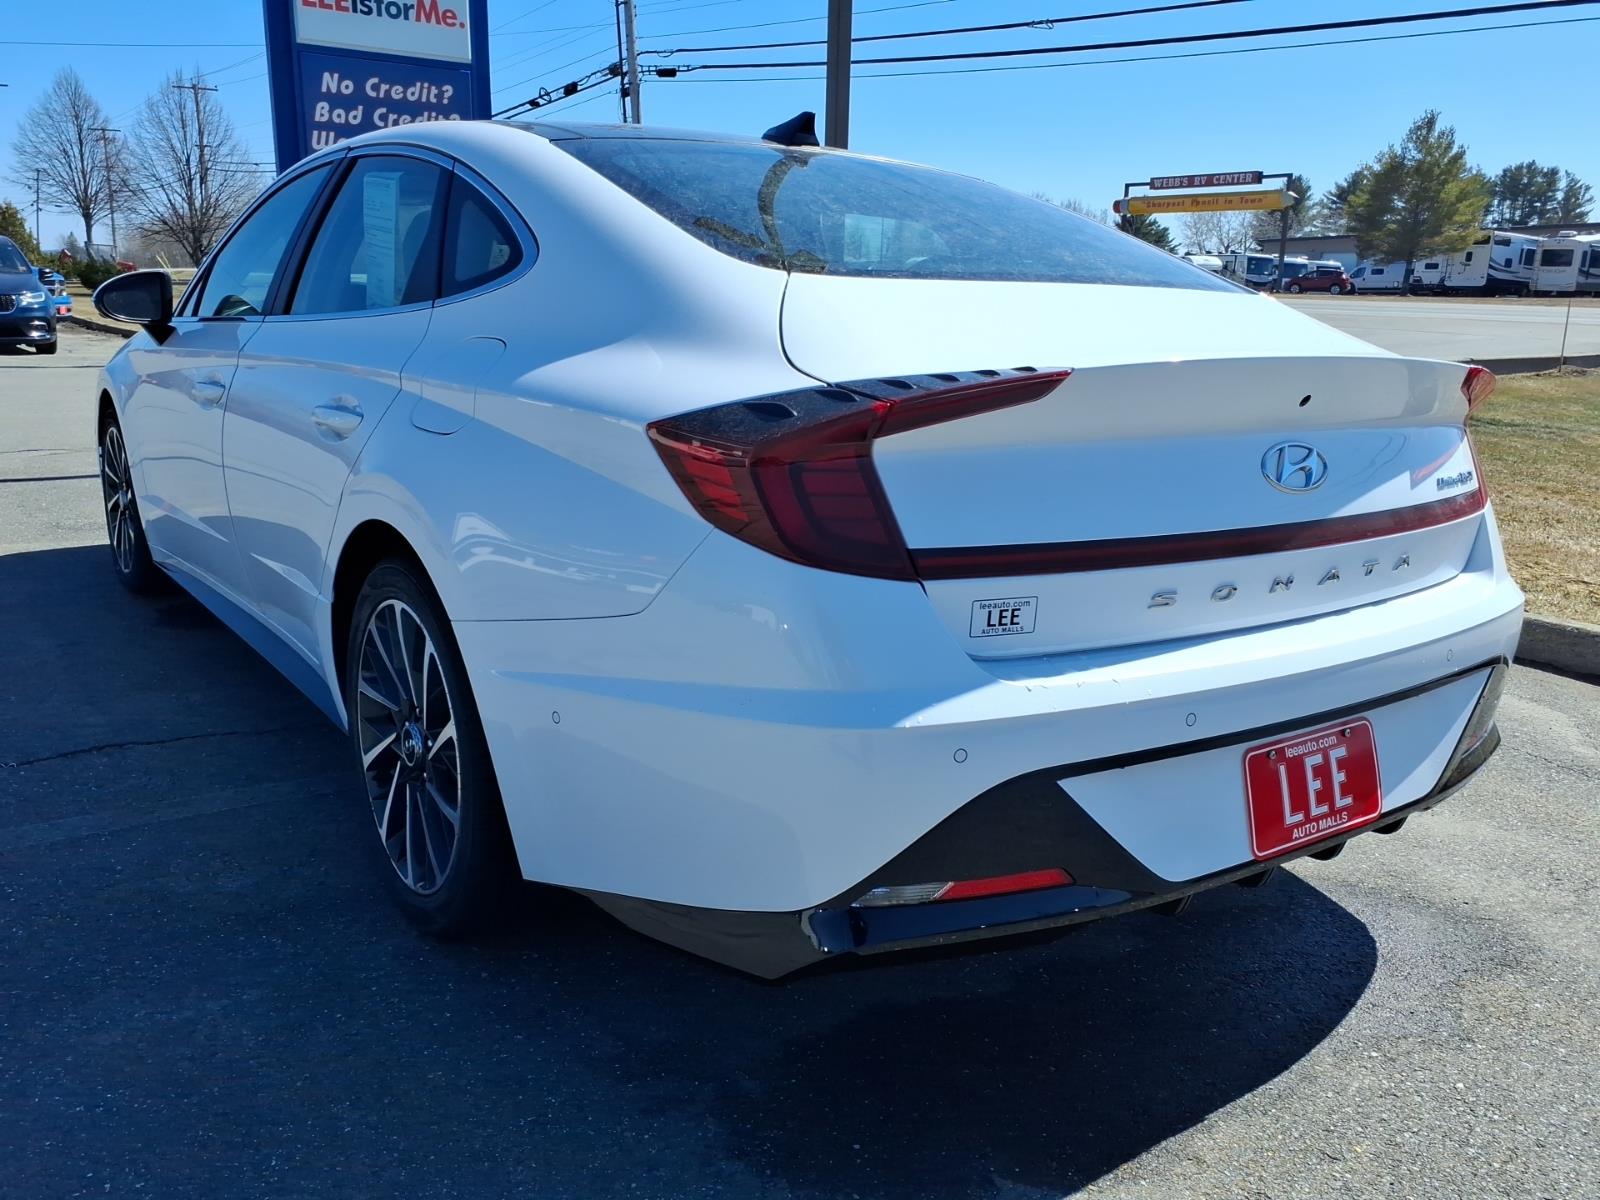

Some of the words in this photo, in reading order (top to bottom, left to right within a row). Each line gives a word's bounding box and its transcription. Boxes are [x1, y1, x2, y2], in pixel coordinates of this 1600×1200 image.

[301, 0, 466, 29] isforMe.
[322, 72, 354, 95] No
[366, 78, 453, 104] Credit?
[314, 101, 363, 124] Bad
[1153, 177, 1189, 188] WEBB'S
[1193, 175, 1208, 186] RV
[1213, 172, 1253, 184] CENTER
[1147, 551, 1411, 609] SONATA
[980, 601, 1030, 609] leeauto.com
[987, 608, 1021, 627] LEE
[981, 627, 1000, 635] AUTO
[1001, 625, 1025, 633] MALLS
[1285, 736, 1336, 757] leeauto.com
[1279, 746, 1352, 826] LEE
[1293, 824, 1318, 839] AUTO
[1319, 812, 1348, 830] MALLS
